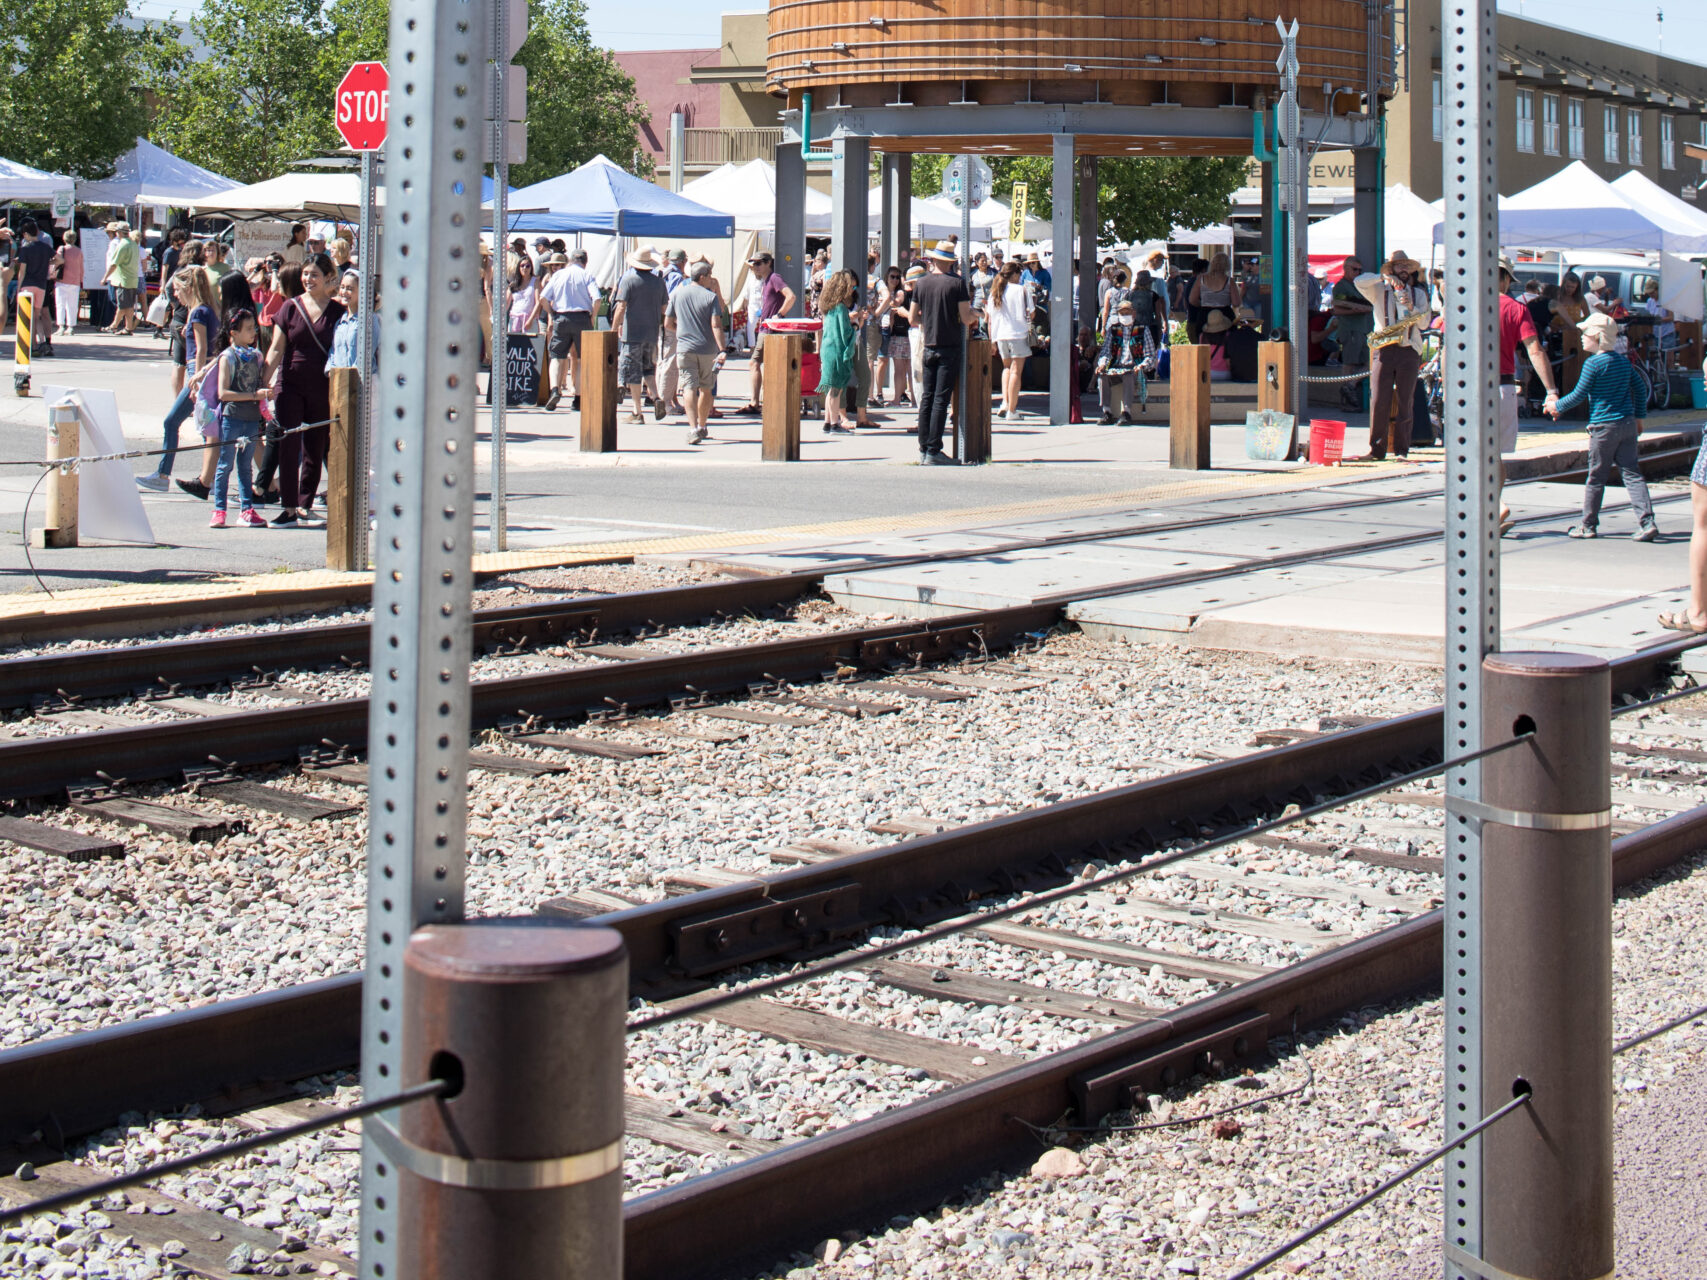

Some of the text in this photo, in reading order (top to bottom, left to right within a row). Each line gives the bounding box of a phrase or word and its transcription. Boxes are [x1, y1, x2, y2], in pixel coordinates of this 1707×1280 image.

[1013, 189, 1024, 239] Honey
[506, 360, 532, 376] OUR
[506, 376, 532, 391] IKE
